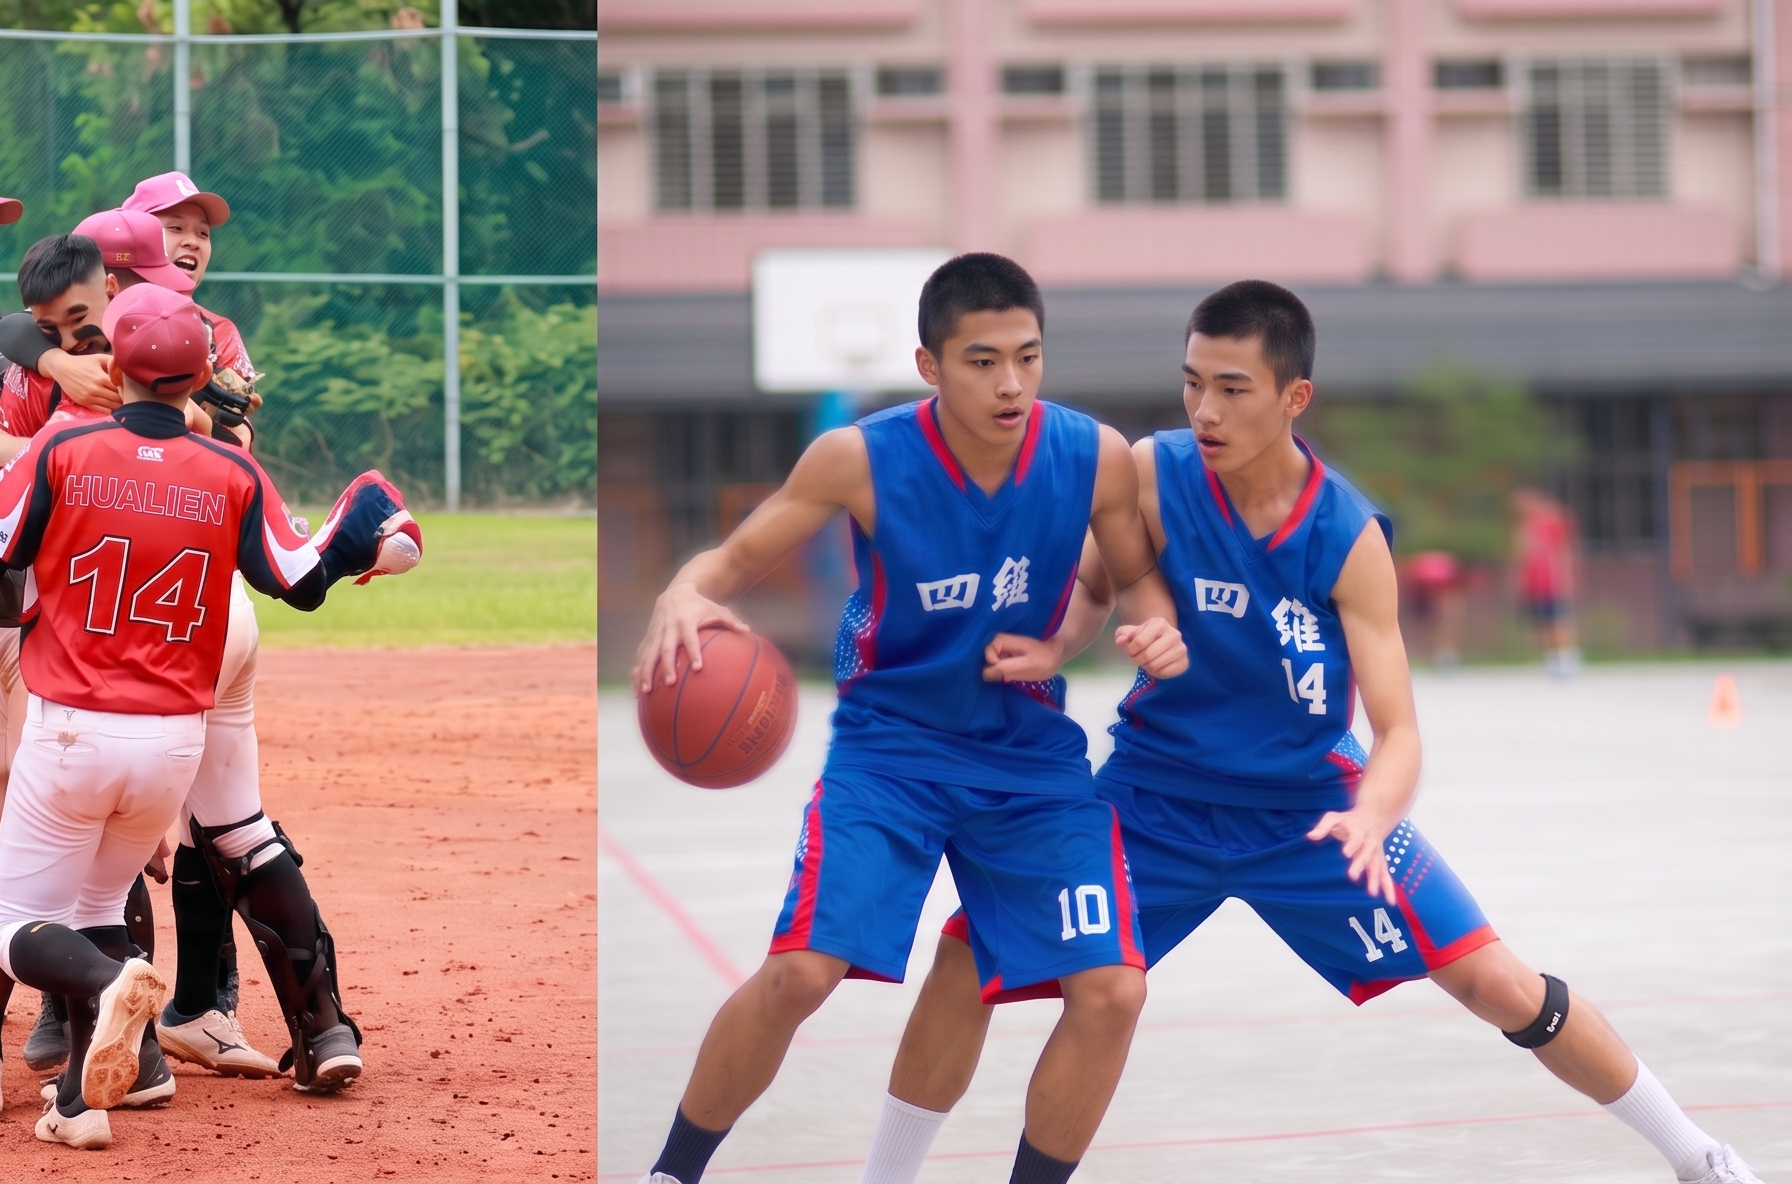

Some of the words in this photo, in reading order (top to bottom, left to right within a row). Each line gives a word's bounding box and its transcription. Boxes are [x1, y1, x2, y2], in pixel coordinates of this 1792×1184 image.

[65, 474, 226, 526] HUALIEN
[69, 535, 210, 642] 14
[1194, 577, 1326, 653] 四維
[1281, 657, 1327, 715] 14
[1058, 884, 1111, 941] 10
[1348, 907, 1408, 963] 14
